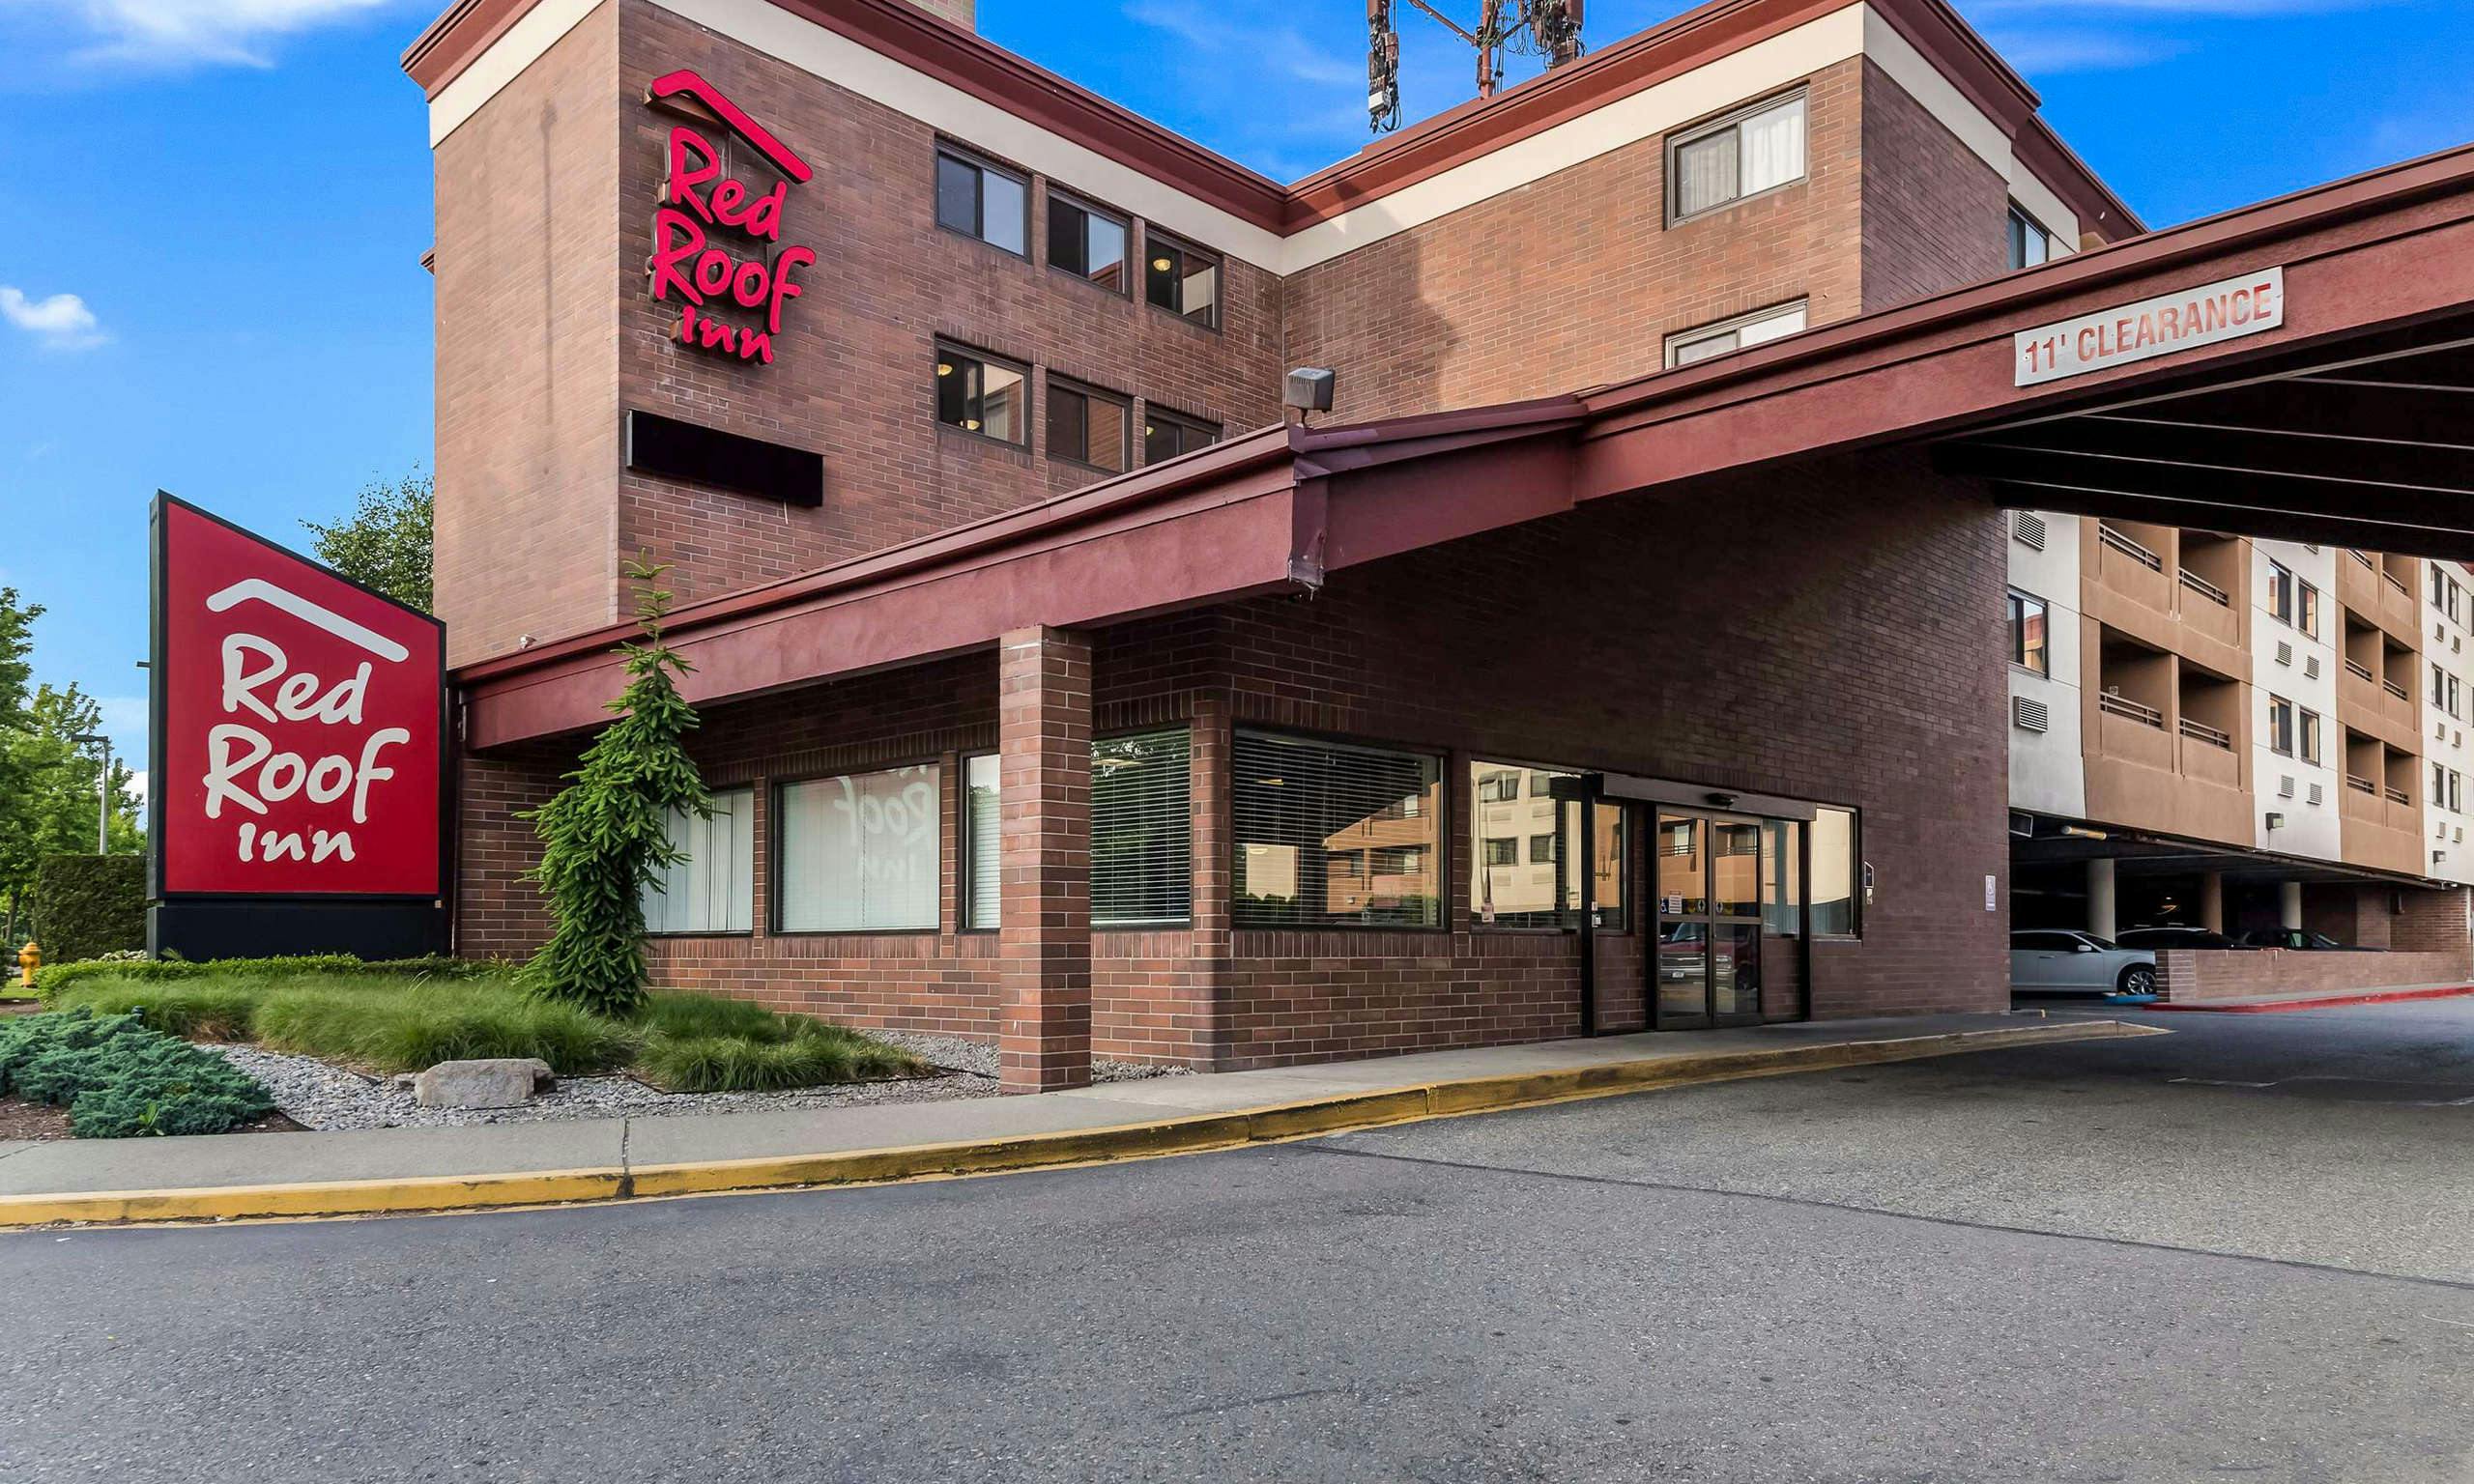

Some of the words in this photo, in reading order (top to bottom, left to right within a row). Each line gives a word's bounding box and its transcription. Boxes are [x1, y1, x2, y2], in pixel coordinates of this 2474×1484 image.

[669, 127, 787, 241] Red
[651, 209, 817, 334] Roof
[681, 305, 774, 364] Inn
[2026, 333, 2066, 373] 11'
[2077, 282, 2272, 362] CLEARANCE
[221, 633, 373, 725] Red
[202, 724, 411, 823] Roof
[238, 822, 357, 864] Inn
